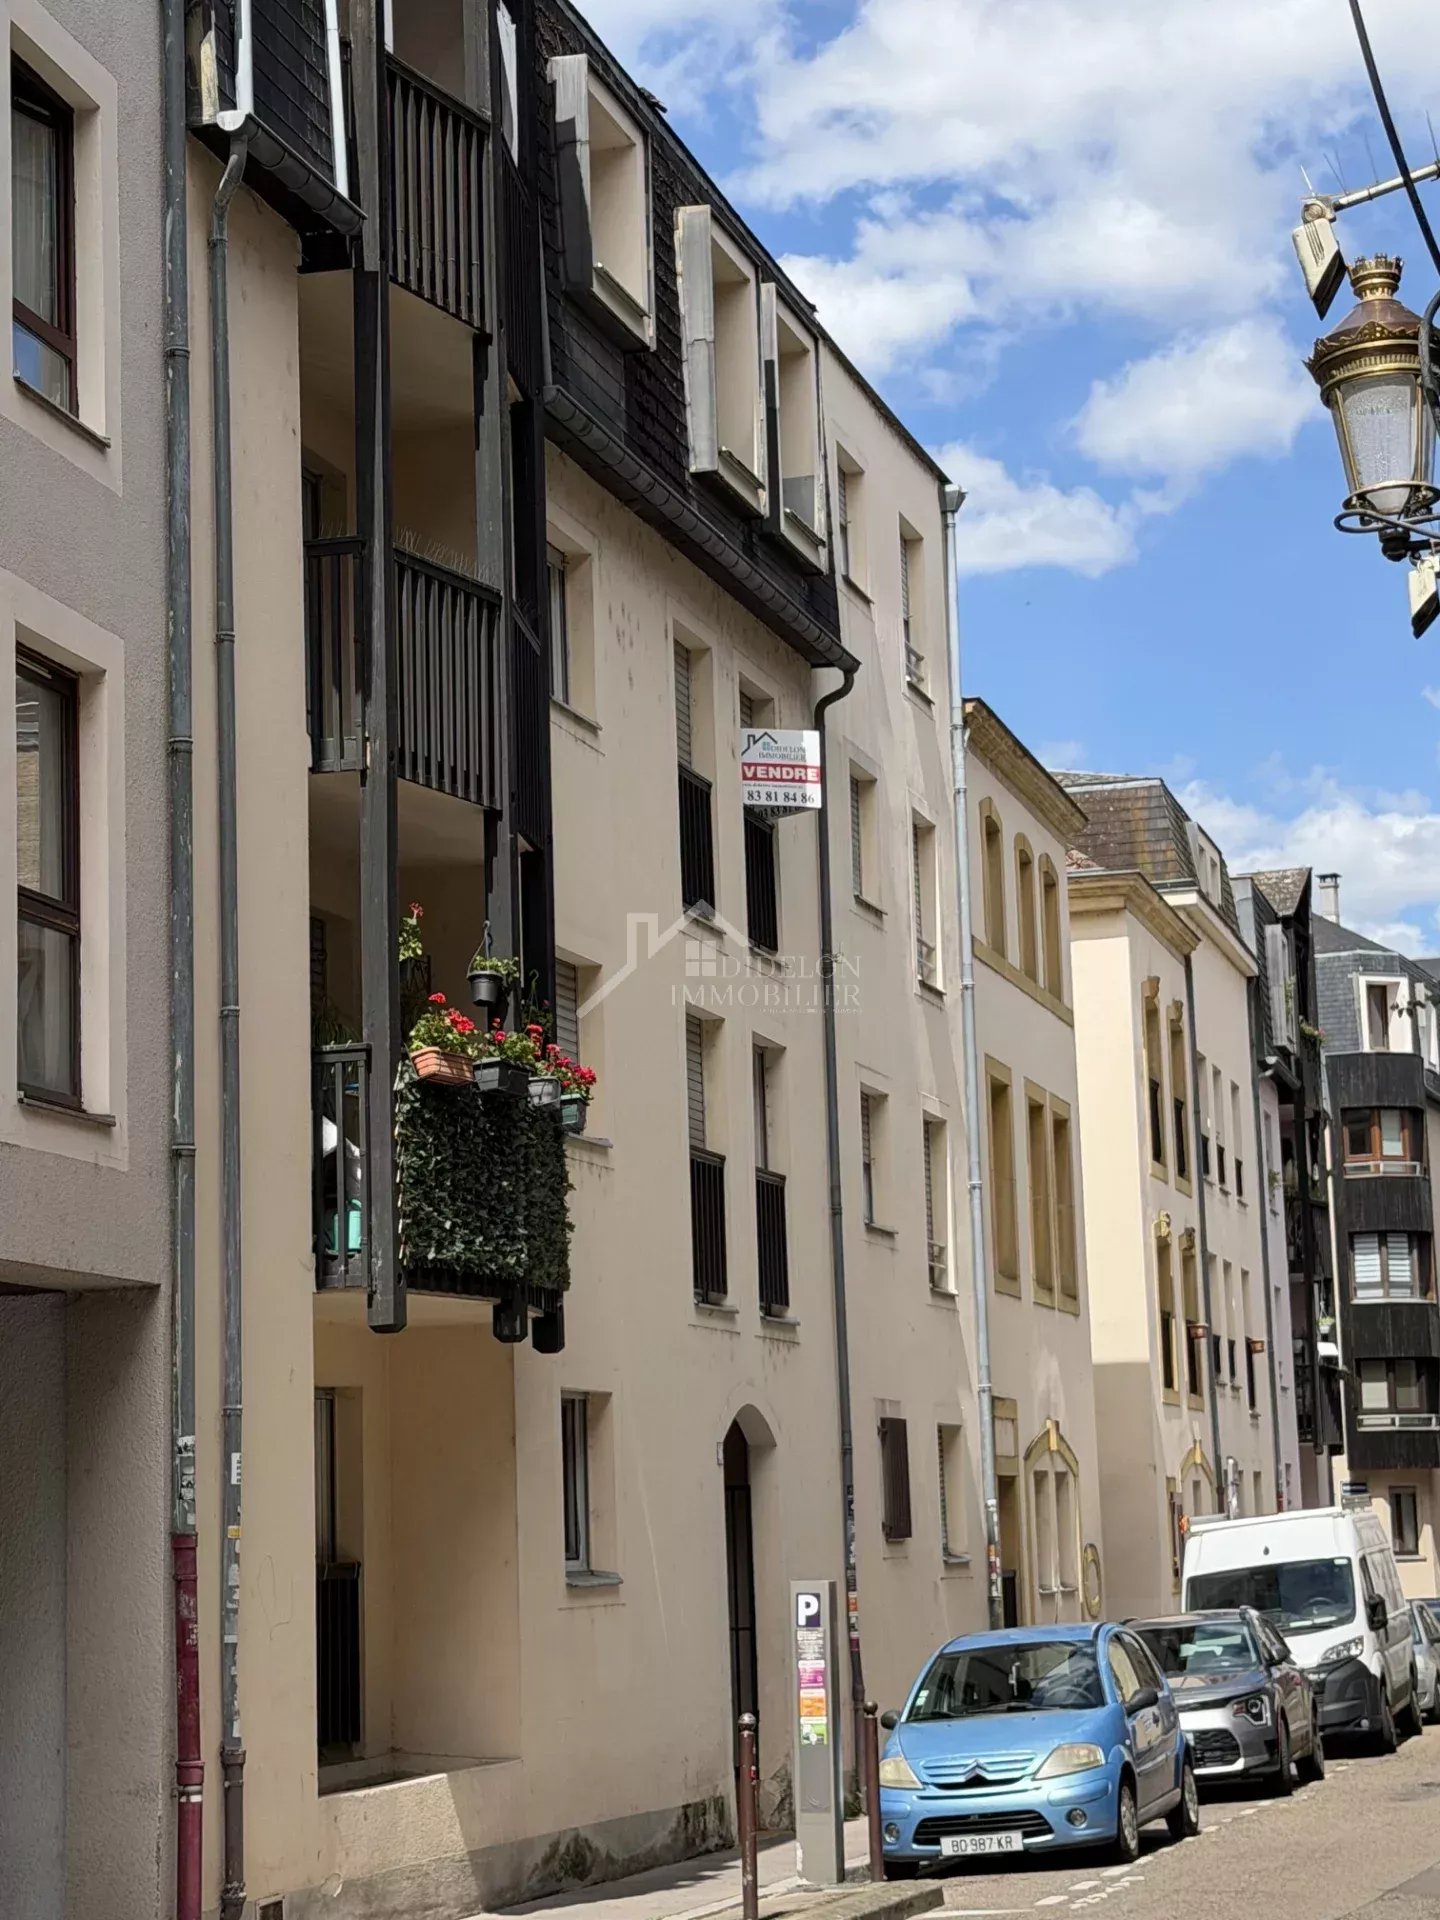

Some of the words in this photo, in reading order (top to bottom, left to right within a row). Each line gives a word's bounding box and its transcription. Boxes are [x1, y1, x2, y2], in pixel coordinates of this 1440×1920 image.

[743, 765, 818, 781] VENDRE
[747, 789, 761, 802] 83
[765, 790, 778, 803] 81
[783, 791, 797, 803] 84
[800, 792, 815, 804] 86
[798, 1594, 819, 1626] P
